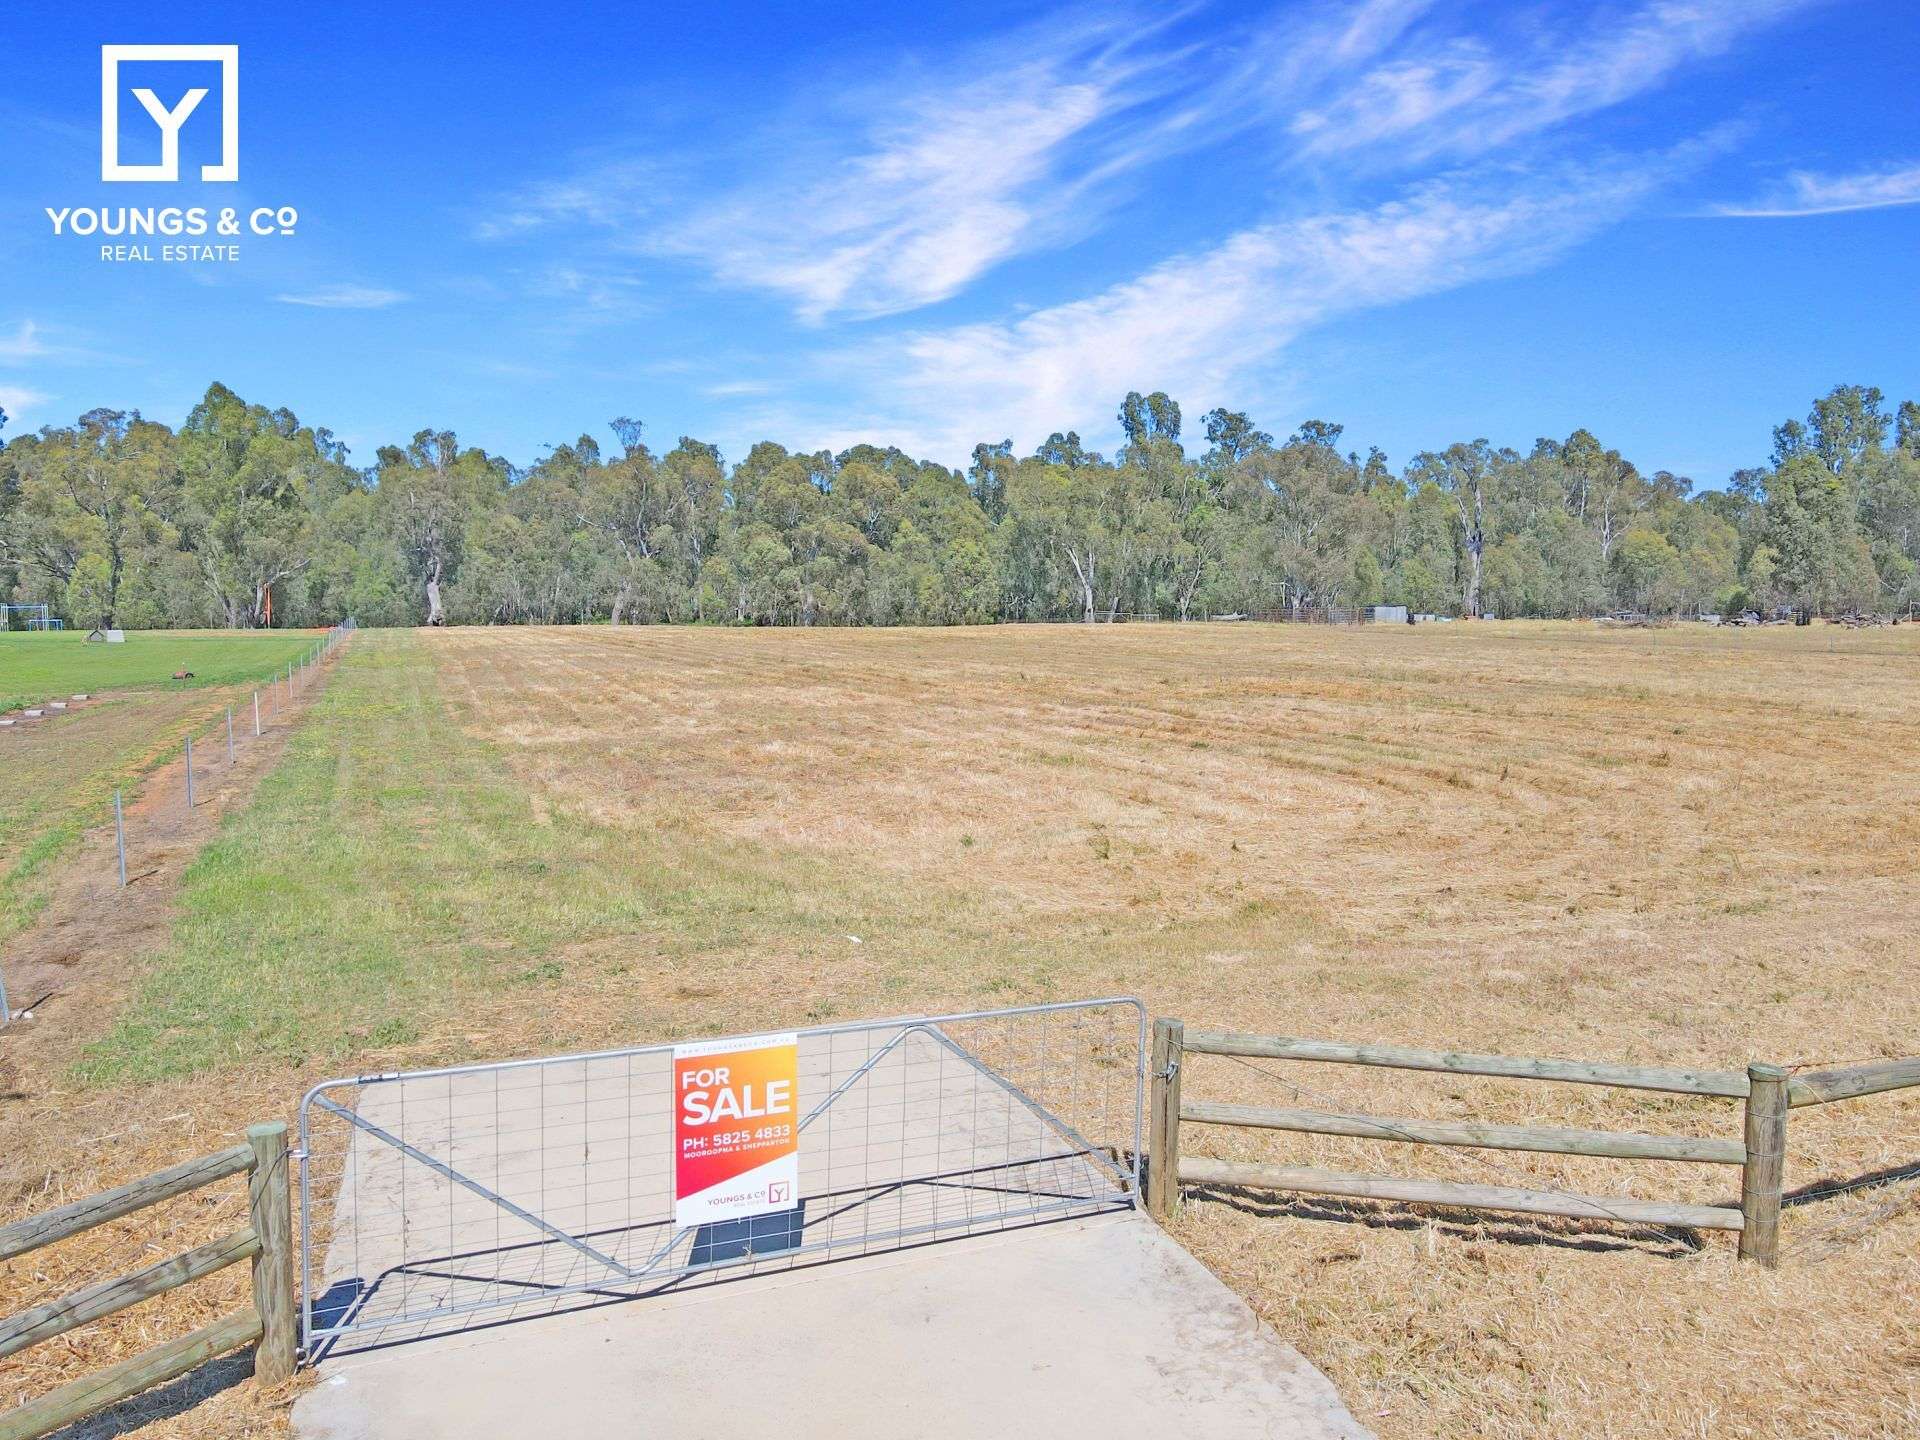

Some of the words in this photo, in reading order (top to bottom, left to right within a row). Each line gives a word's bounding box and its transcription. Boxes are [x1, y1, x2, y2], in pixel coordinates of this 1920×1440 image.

[683, 1068, 729, 1089] FOR
[683, 1080, 790, 1125] SALE
[683, 1137, 708, 1150] PH:
[713, 1131, 751, 1146] 5825
[755, 1125, 790, 1139] 4833
[707, 1194, 745, 1206] YOUNGS
